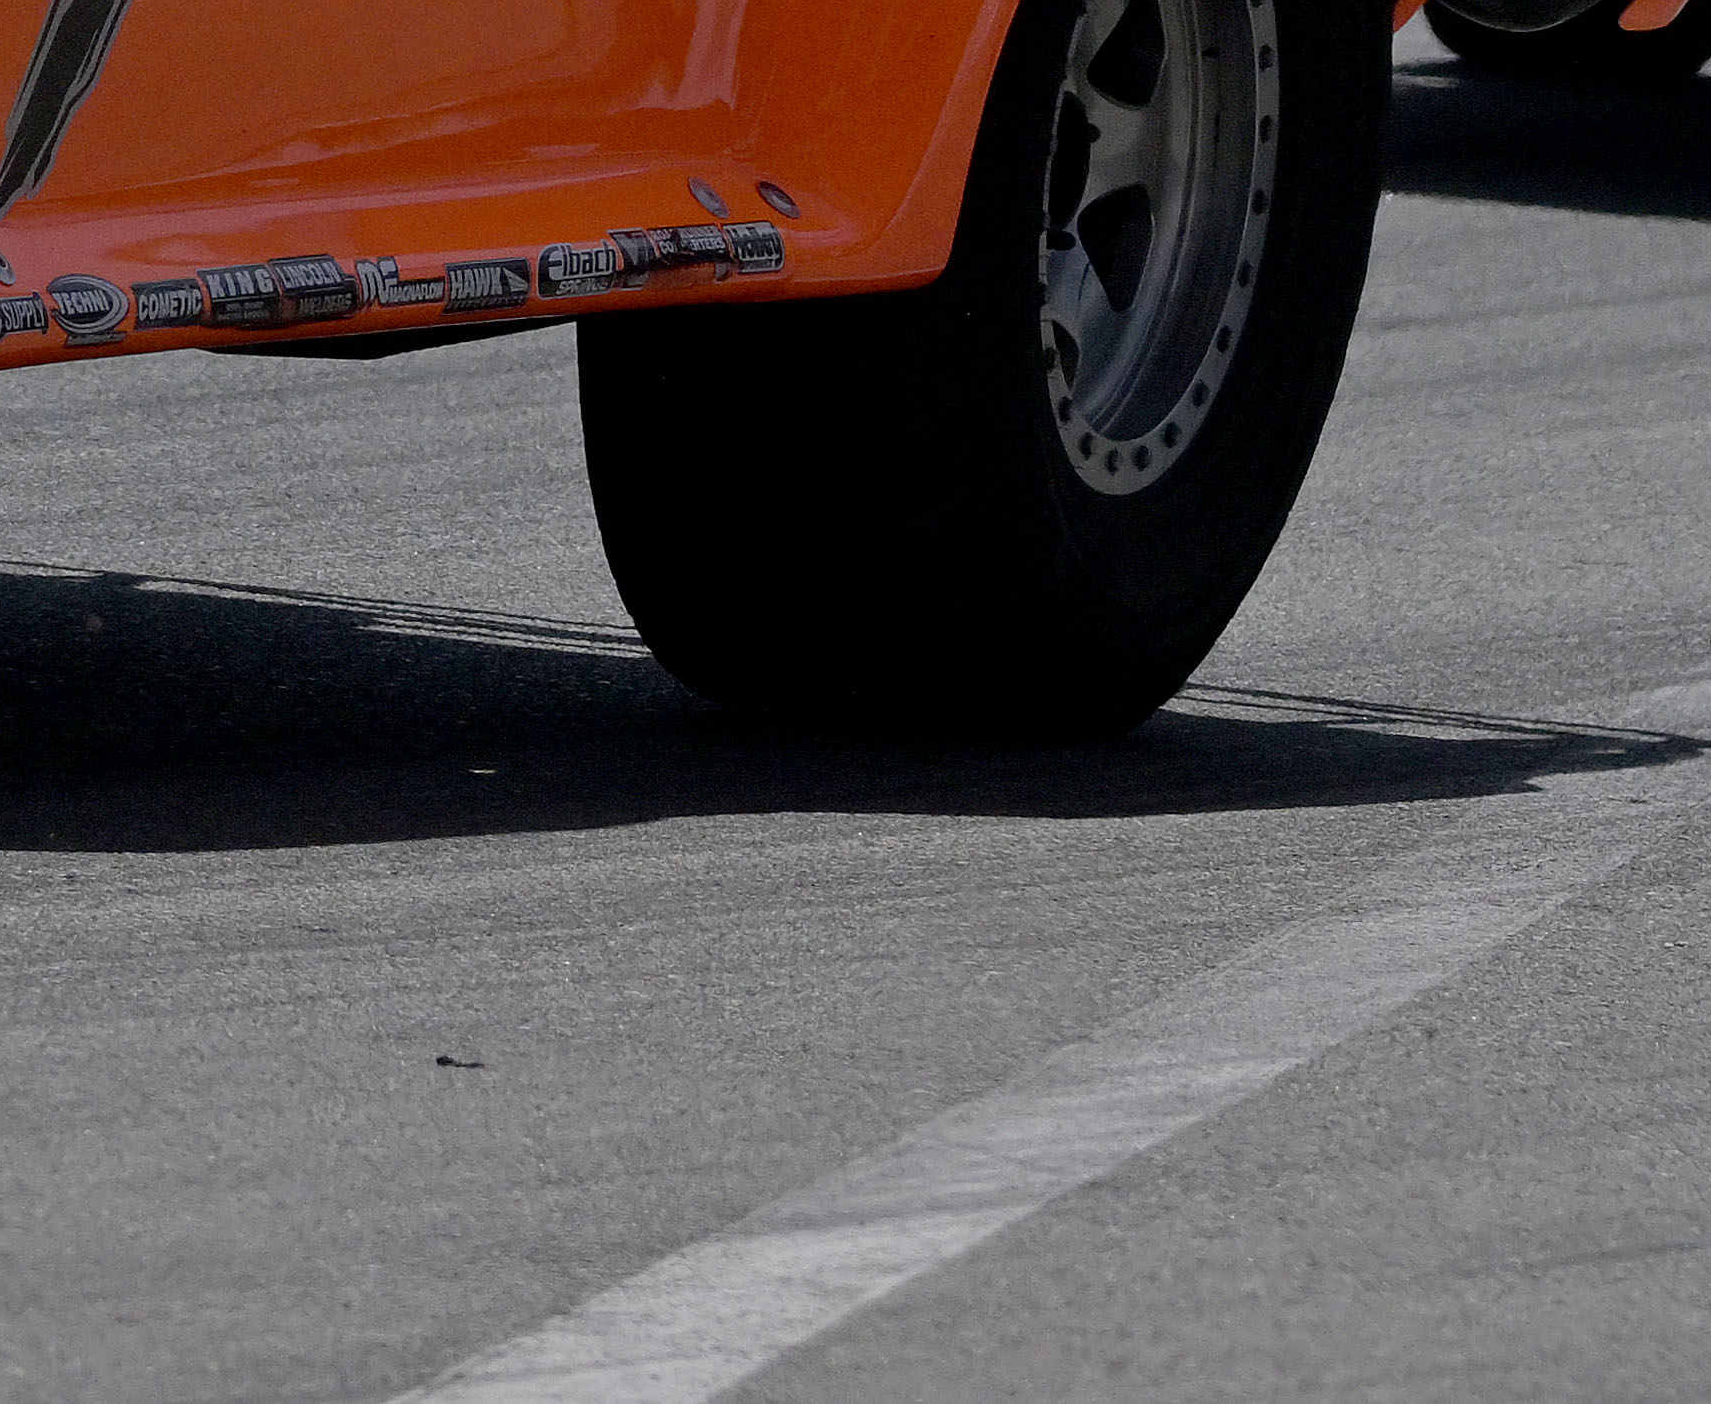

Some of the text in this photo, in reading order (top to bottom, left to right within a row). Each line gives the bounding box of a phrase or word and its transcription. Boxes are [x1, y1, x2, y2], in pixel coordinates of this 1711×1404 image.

[207, 268, 275, 299] KING
[277, 260, 341, 289] LINCOLN
[448, 267, 504, 298] HAWK
[1, 298, 45, 330] SUPPLY
[137, 288, 202, 322] COMETIC
